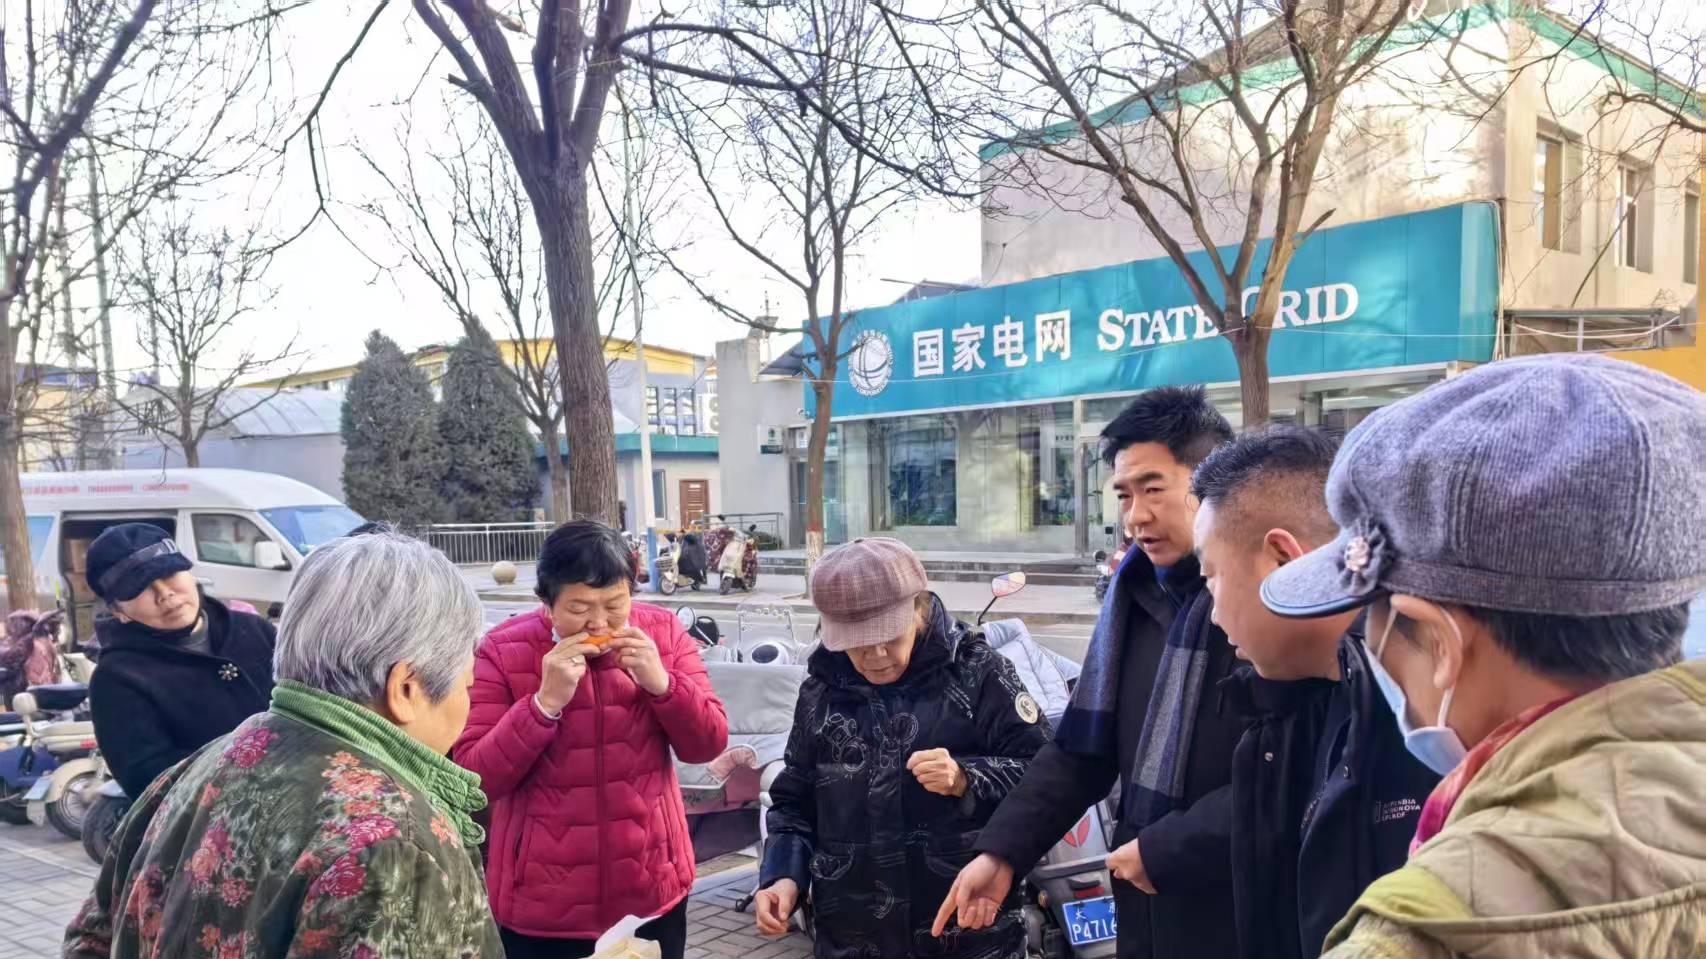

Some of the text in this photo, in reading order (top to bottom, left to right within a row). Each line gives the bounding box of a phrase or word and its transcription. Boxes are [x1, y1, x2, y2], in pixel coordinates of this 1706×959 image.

[913, 309, 1071, 377] 国家电网
[1097, 304, 1219, 350] STATE
